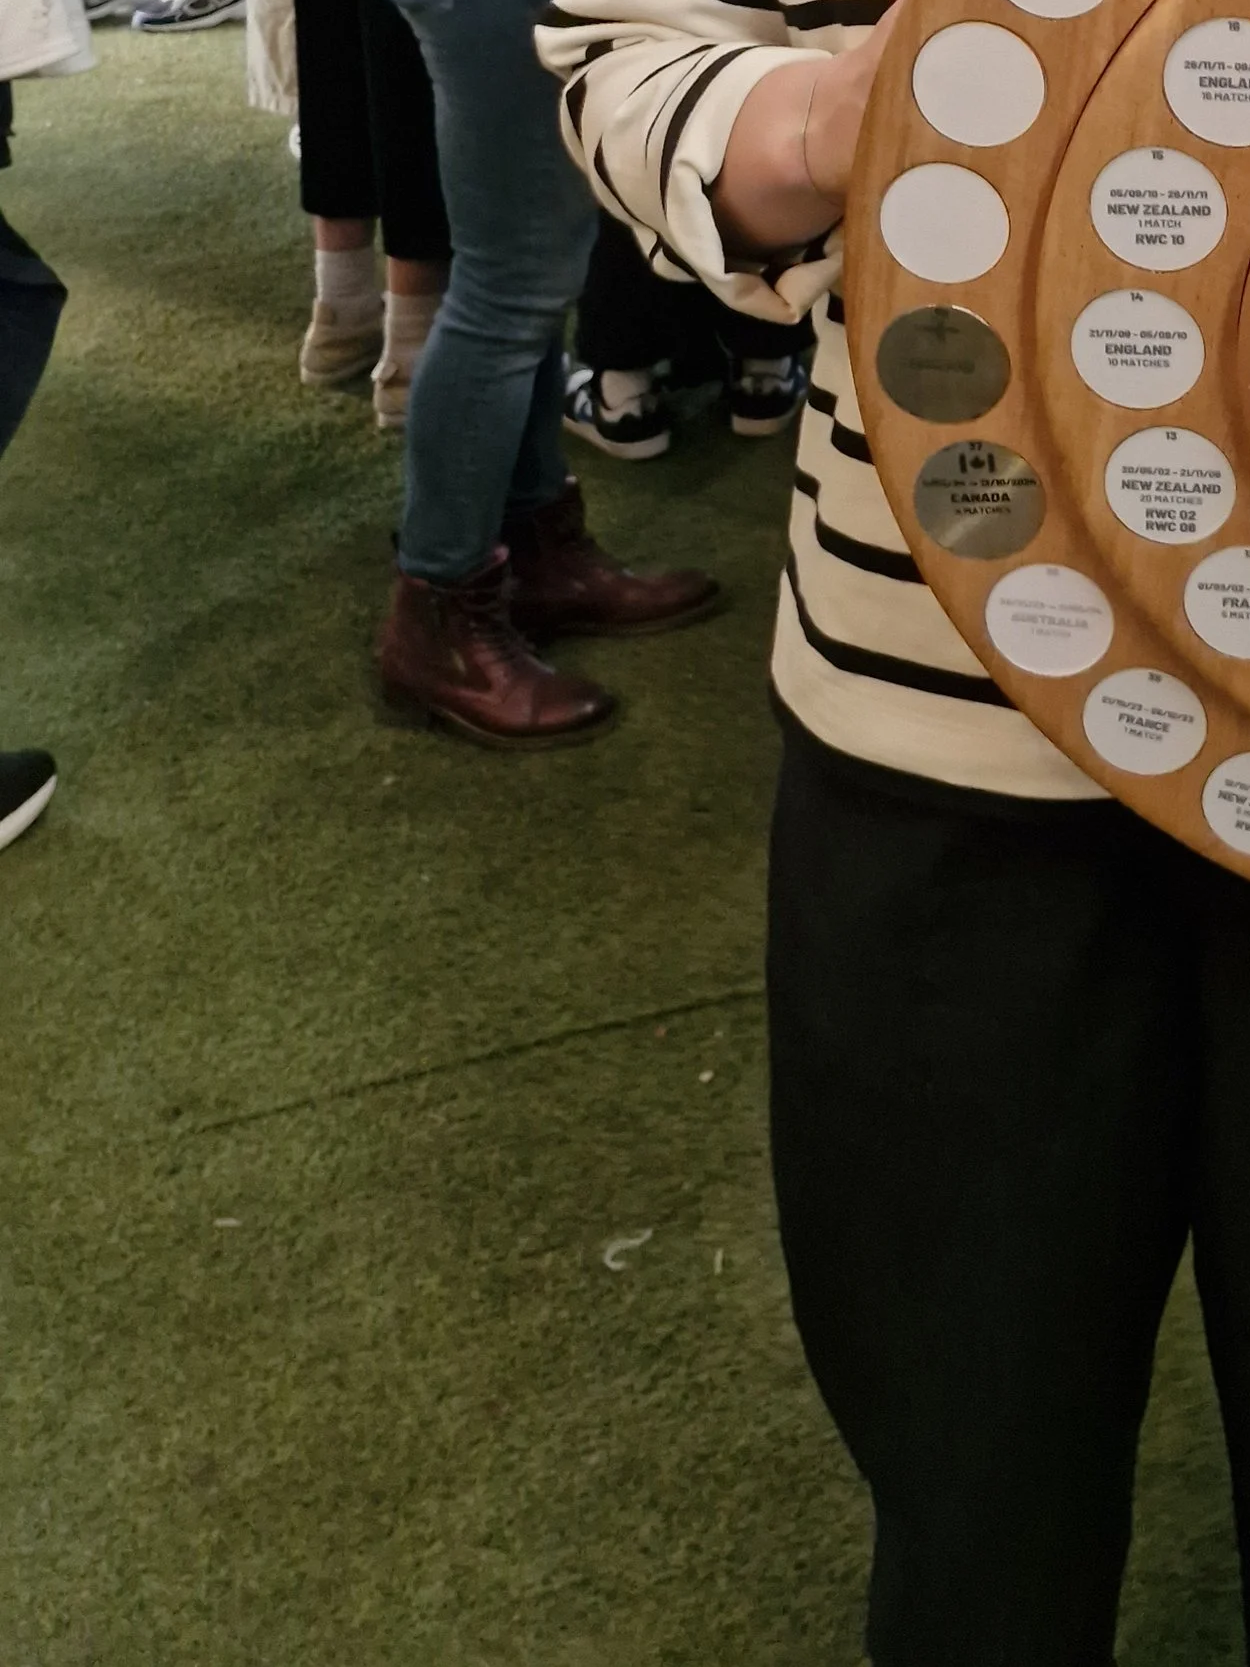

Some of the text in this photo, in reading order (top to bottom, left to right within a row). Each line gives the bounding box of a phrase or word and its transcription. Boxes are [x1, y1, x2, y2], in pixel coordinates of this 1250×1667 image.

[1228, 21, 1240, 31] 16
[1151, 150, 1163, 160] 15
[1108, 204, 1211, 216] NEW ZEALAND
[1144, 219, 1181, 228] MATCH
[1136, 234, 1184, 245] RWC 10
[1131, 292, 1143, 302] 14
[1105, 344, 1172, 356] ENGLAND
[1121, 358, 1170, 368] MATCHES
[1166, 431, 1176, 441] 13
[1121, 480, 1221, 494] NEW ZEALAND
[951, 493, 1010, 503] CANADA
[1146, 508, 1196, 520] RWC 02
[1146, 520, 1176, 532] RWC
[1118, 713, 1171, 733] FRANCE
[1218, 790, 1247, 805] NEW
